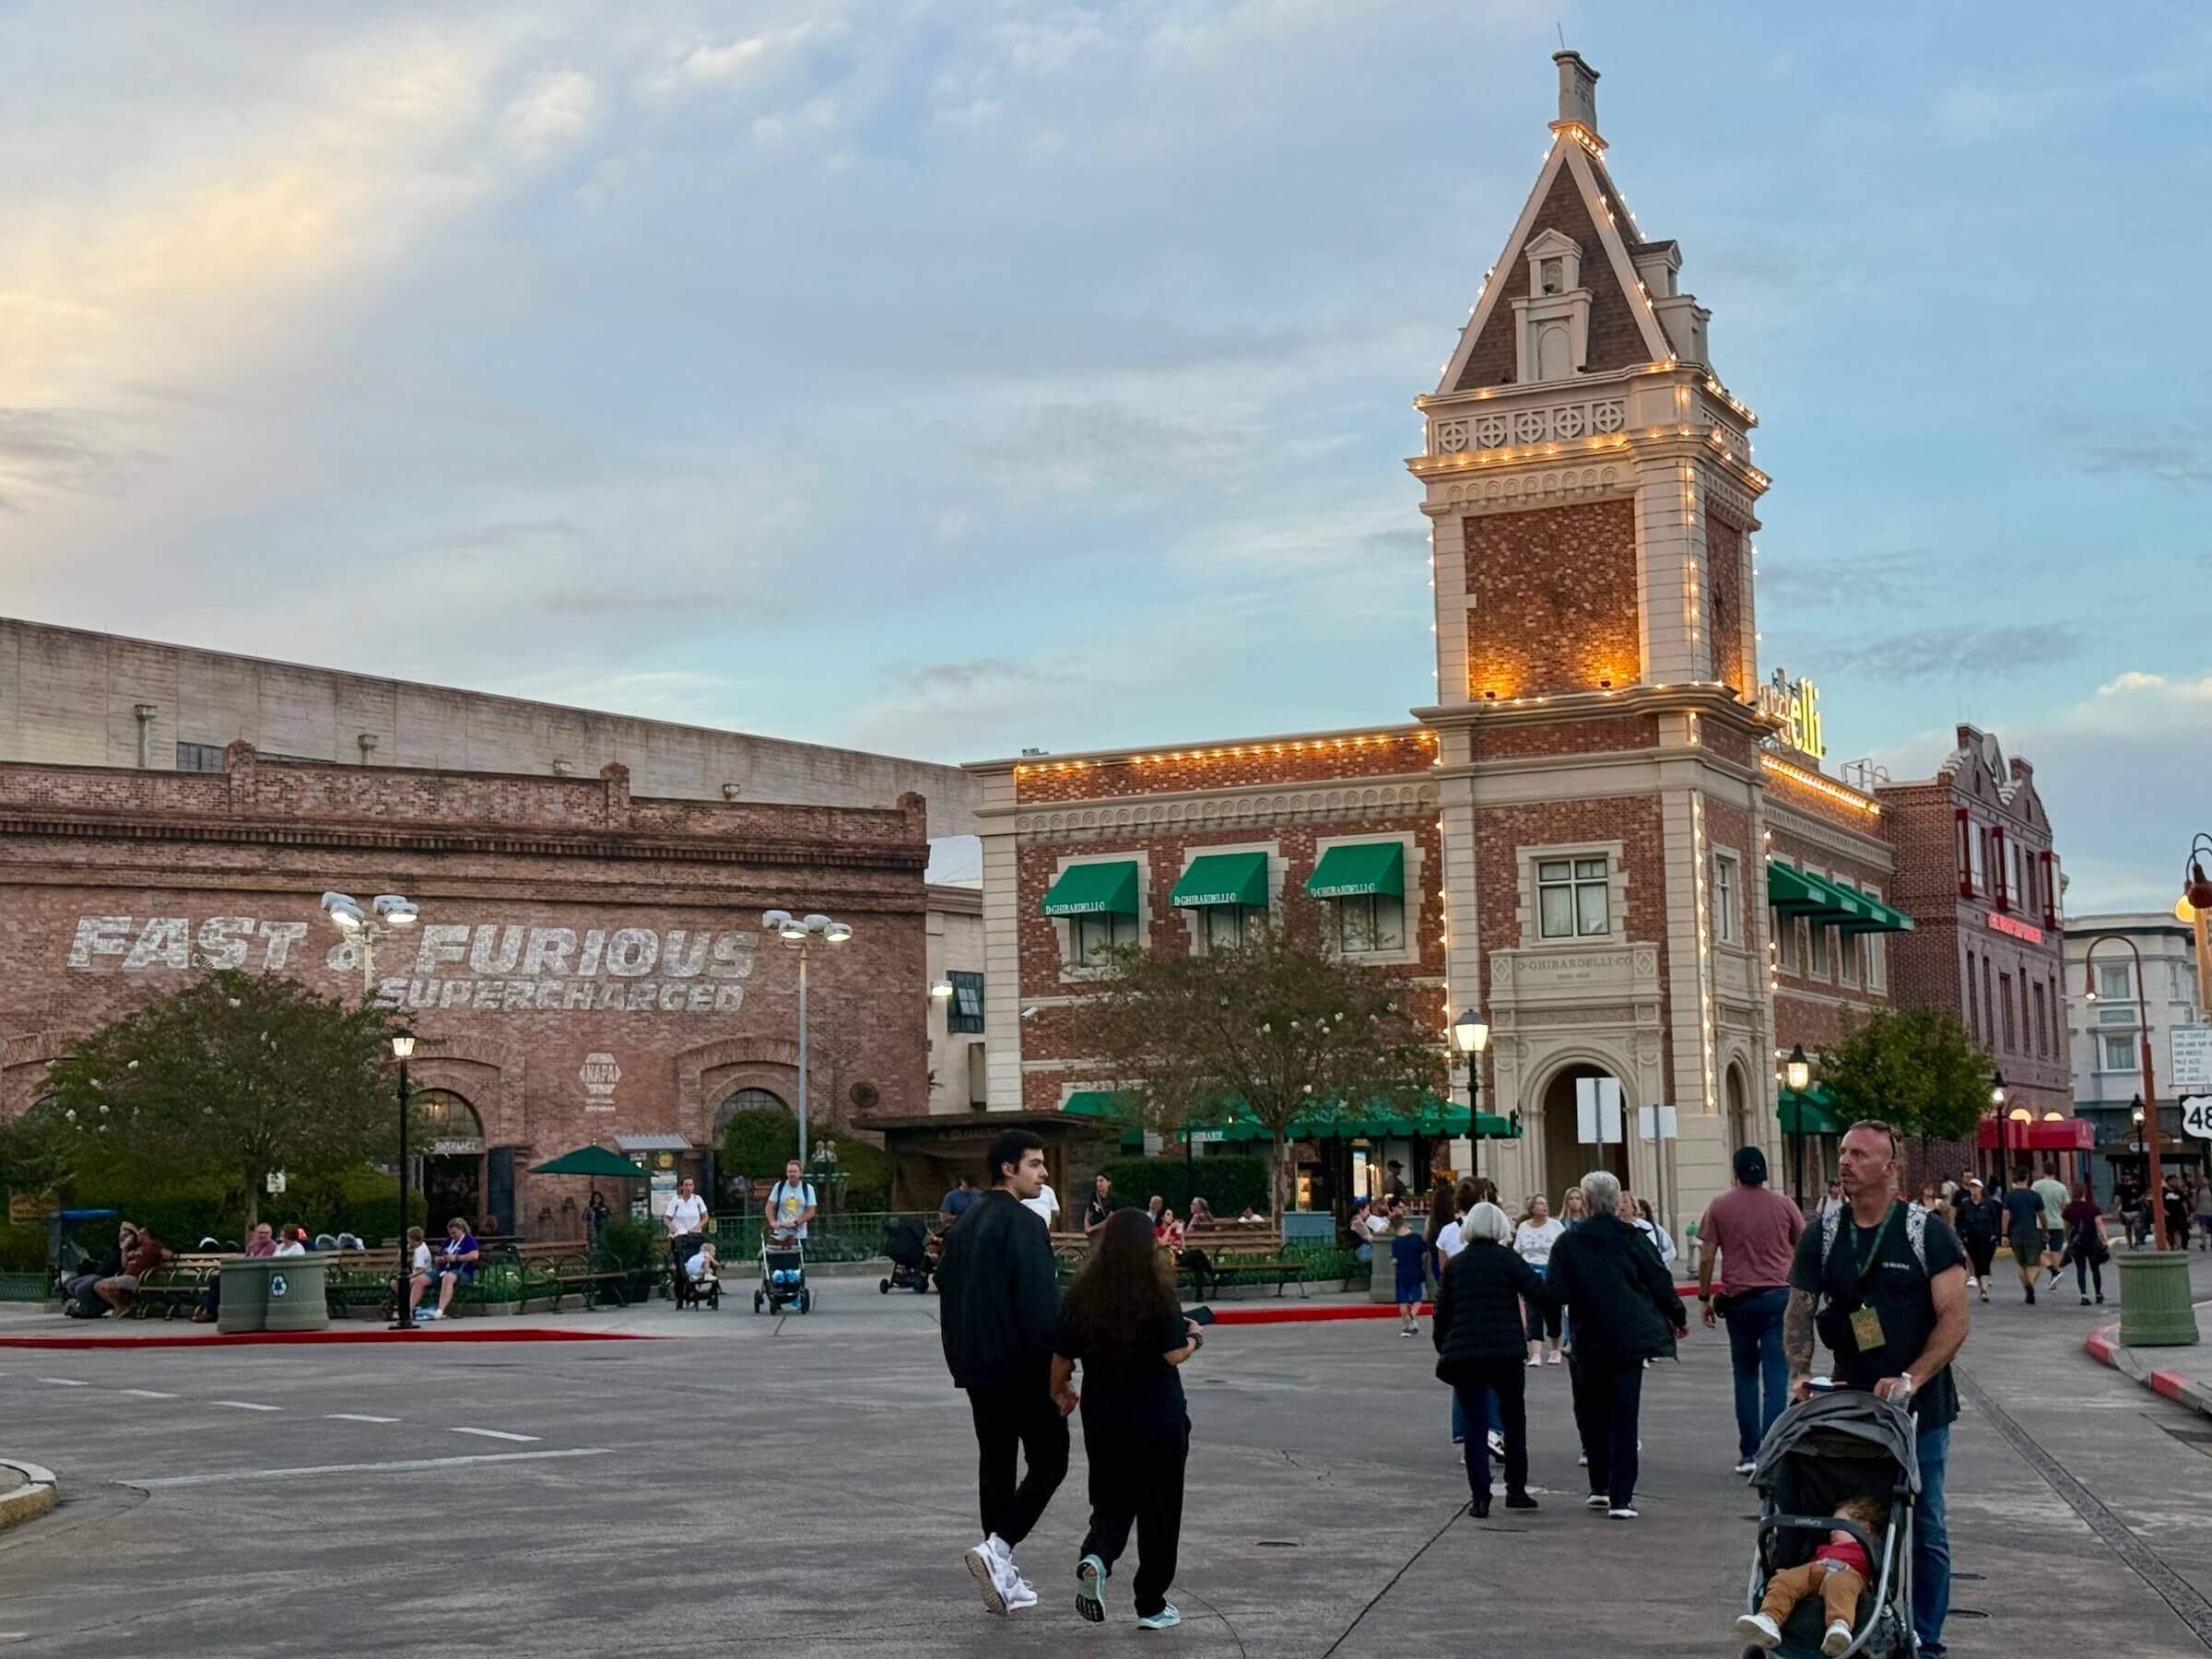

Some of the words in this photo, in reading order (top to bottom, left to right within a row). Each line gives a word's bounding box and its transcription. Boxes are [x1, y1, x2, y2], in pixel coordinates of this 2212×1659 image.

[66, 914, 308, 969] FAST
[325, 924, 376, 971] &
[414, 924, 759, 978] FURIOUS
[372, 977, 746, 1013] SUPERCHARGED
[585, 1064, 616, 1083] NAPA
